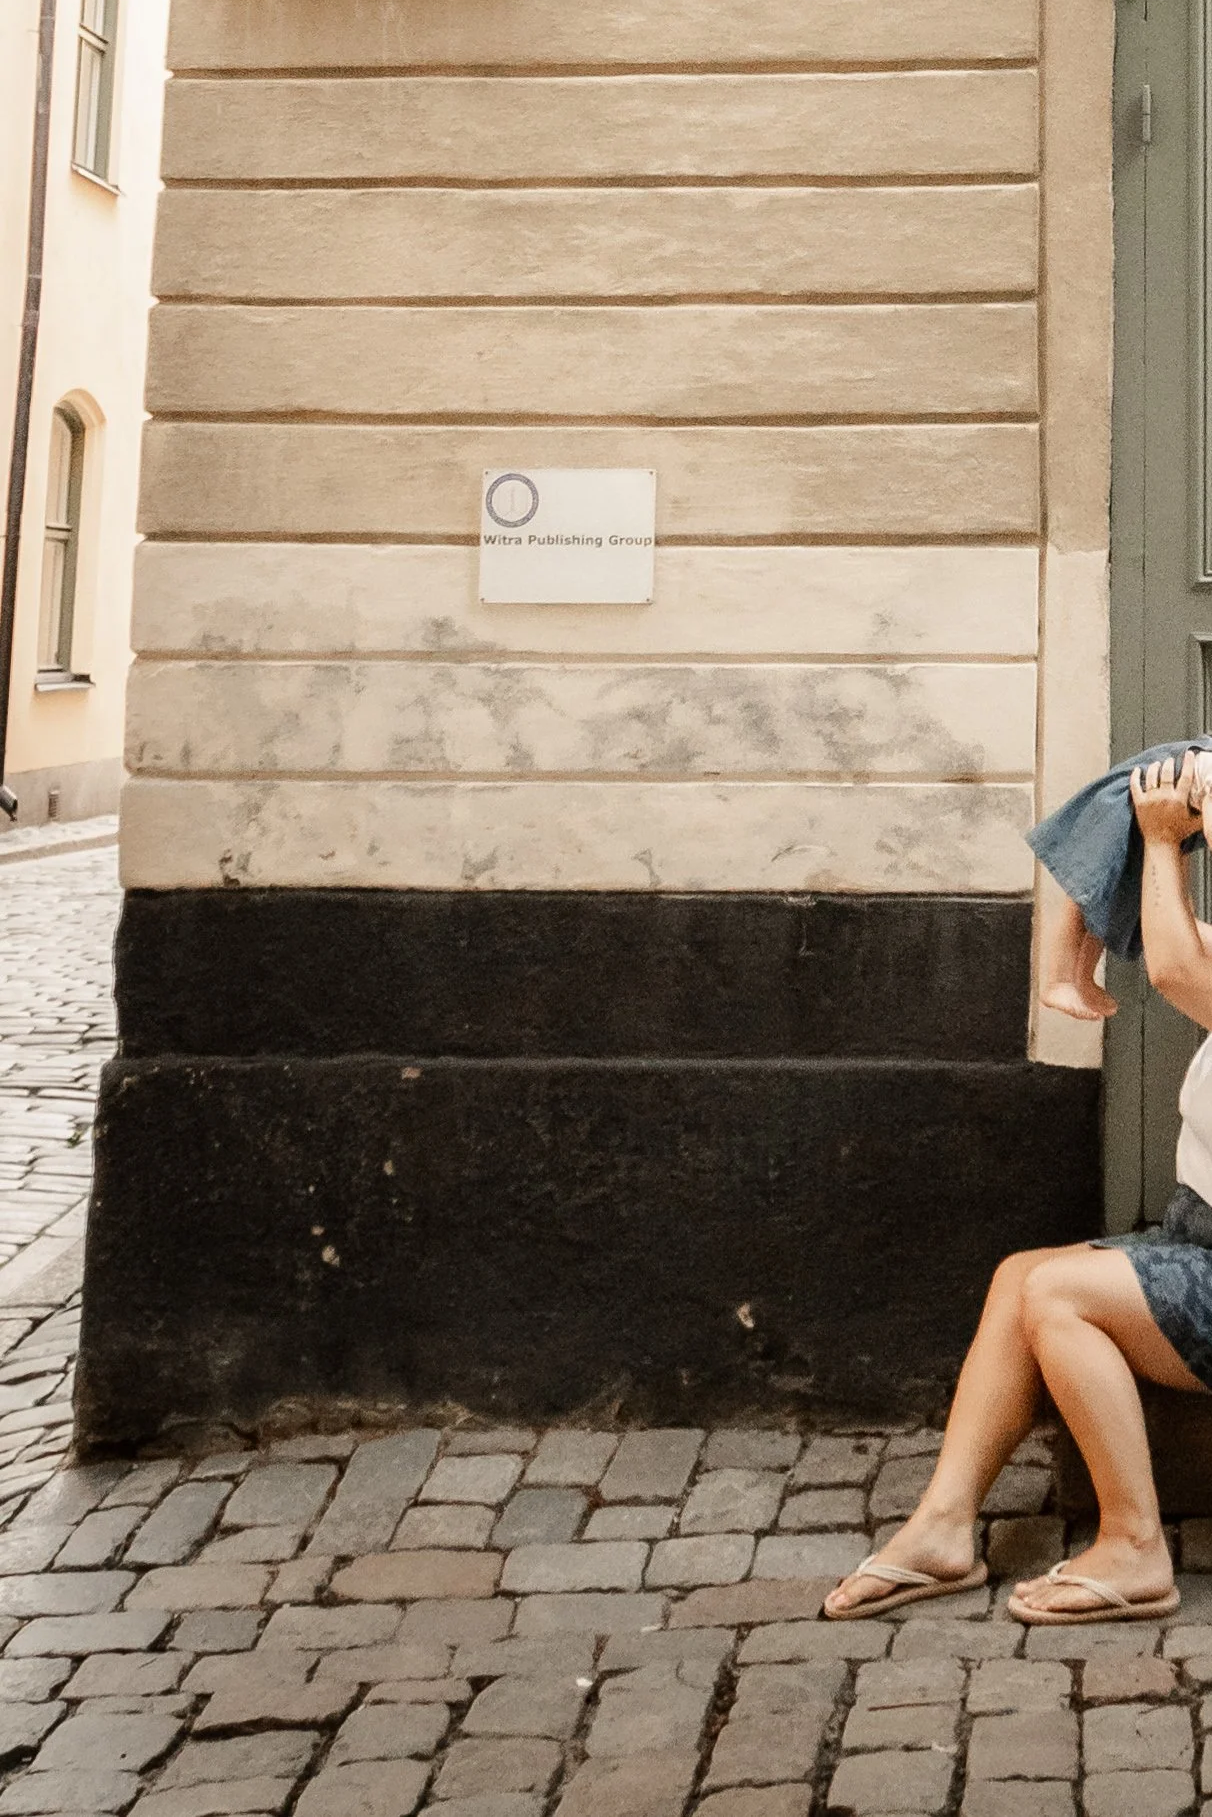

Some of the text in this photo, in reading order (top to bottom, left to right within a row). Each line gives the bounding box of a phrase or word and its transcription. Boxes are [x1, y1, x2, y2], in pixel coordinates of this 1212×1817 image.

[483, 534, 653, 548] Witra Publishing Group
